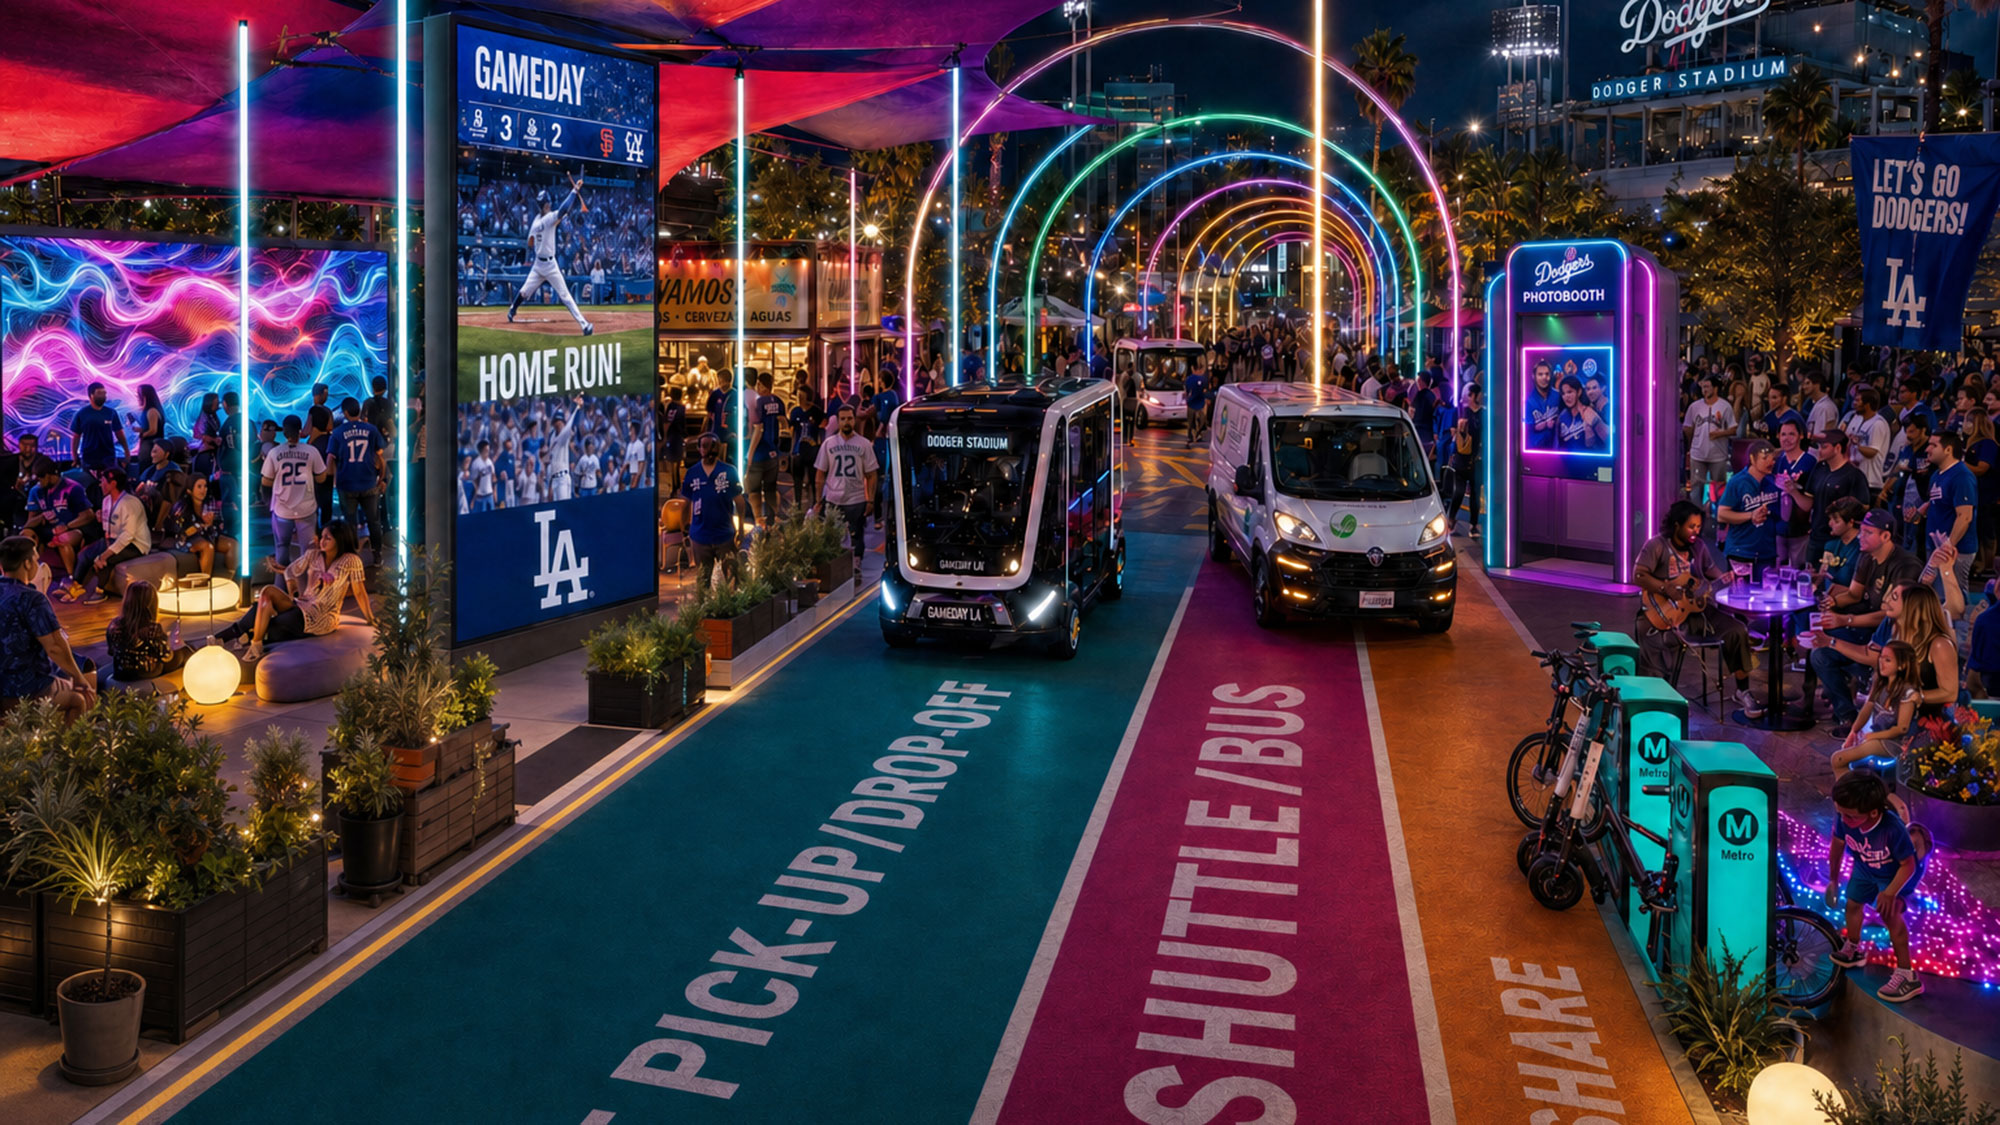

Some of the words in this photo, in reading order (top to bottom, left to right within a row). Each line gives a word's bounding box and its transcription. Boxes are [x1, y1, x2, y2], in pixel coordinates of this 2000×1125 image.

[1619, 0, 1771, 53] Dodge
[475, 46, 585, 106] GAMEDAY
[1592, 77, 1661, 98] DODGER
[1678, 60, 1785, 88] STADIUM
[500, 115, 512, 141] 3
[551, 123, 562, 147] 2
[1872, 159, 1925, 195] LET'S
[1932, 164, 1960, 197] GO
[1872, 196, 1968, 235] DODGERS!
[1535, 254, 1594, 286] Dodgers
[1523, 289, 1605, 303] PHOTOBOOTH
[1882, 258, 1926, 328] LA
[750, 311, 791, 322] AGUAS
[479, 349, 558, 403] HOME
[565, 342, 621, 391] RUN!
[347, 440, 369, 462] 17
[927, 435, 963, 448] DODGER
[966, 437, 1008, 449] STADIUM
[534, 509, 589, 609] LA
[970, 608, 981, 621] LA
[1644, 738, 1667, 758] M
[1639, 768, 1669, 778] Metro
[1726, 813, 1752, 839] M
[1721, 849, 1755, 861] Metro
